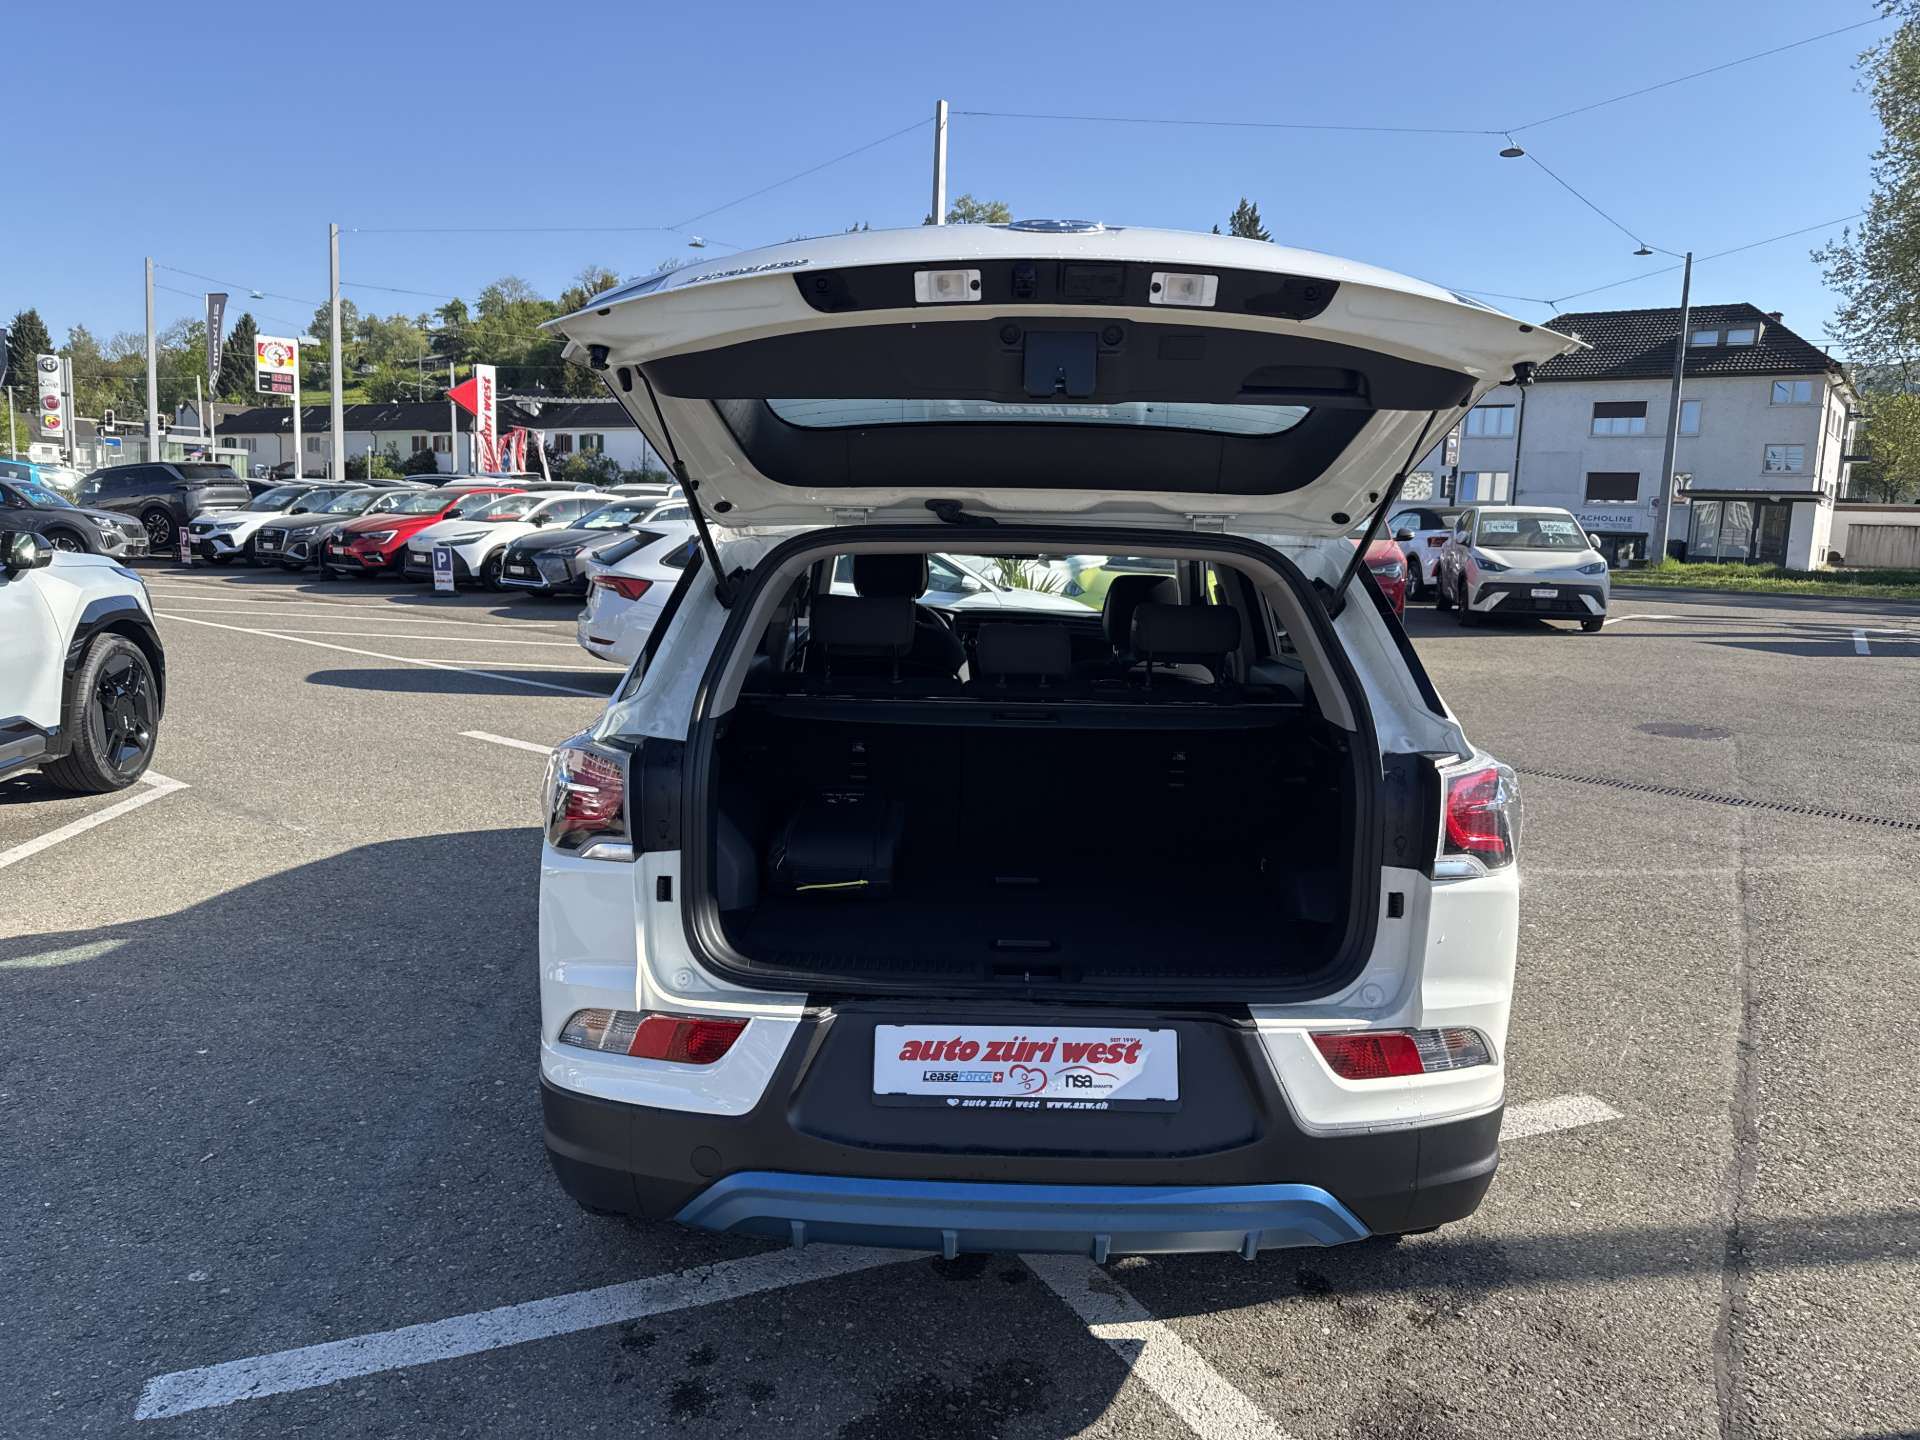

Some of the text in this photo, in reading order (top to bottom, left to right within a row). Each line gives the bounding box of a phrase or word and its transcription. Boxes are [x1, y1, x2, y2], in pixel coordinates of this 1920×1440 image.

[483, 375, 493, 411] west
[1573, 513, 1633, 523] TACHOLINE
[436, 551, 447, 568] P
[898, 1036, 1142, 1065] auto züri west
[1065, 1074, 1093, 1088] nsa
[962, 1099, 987, 1107] auto
[1015, 1100, 1040, 1109] west
